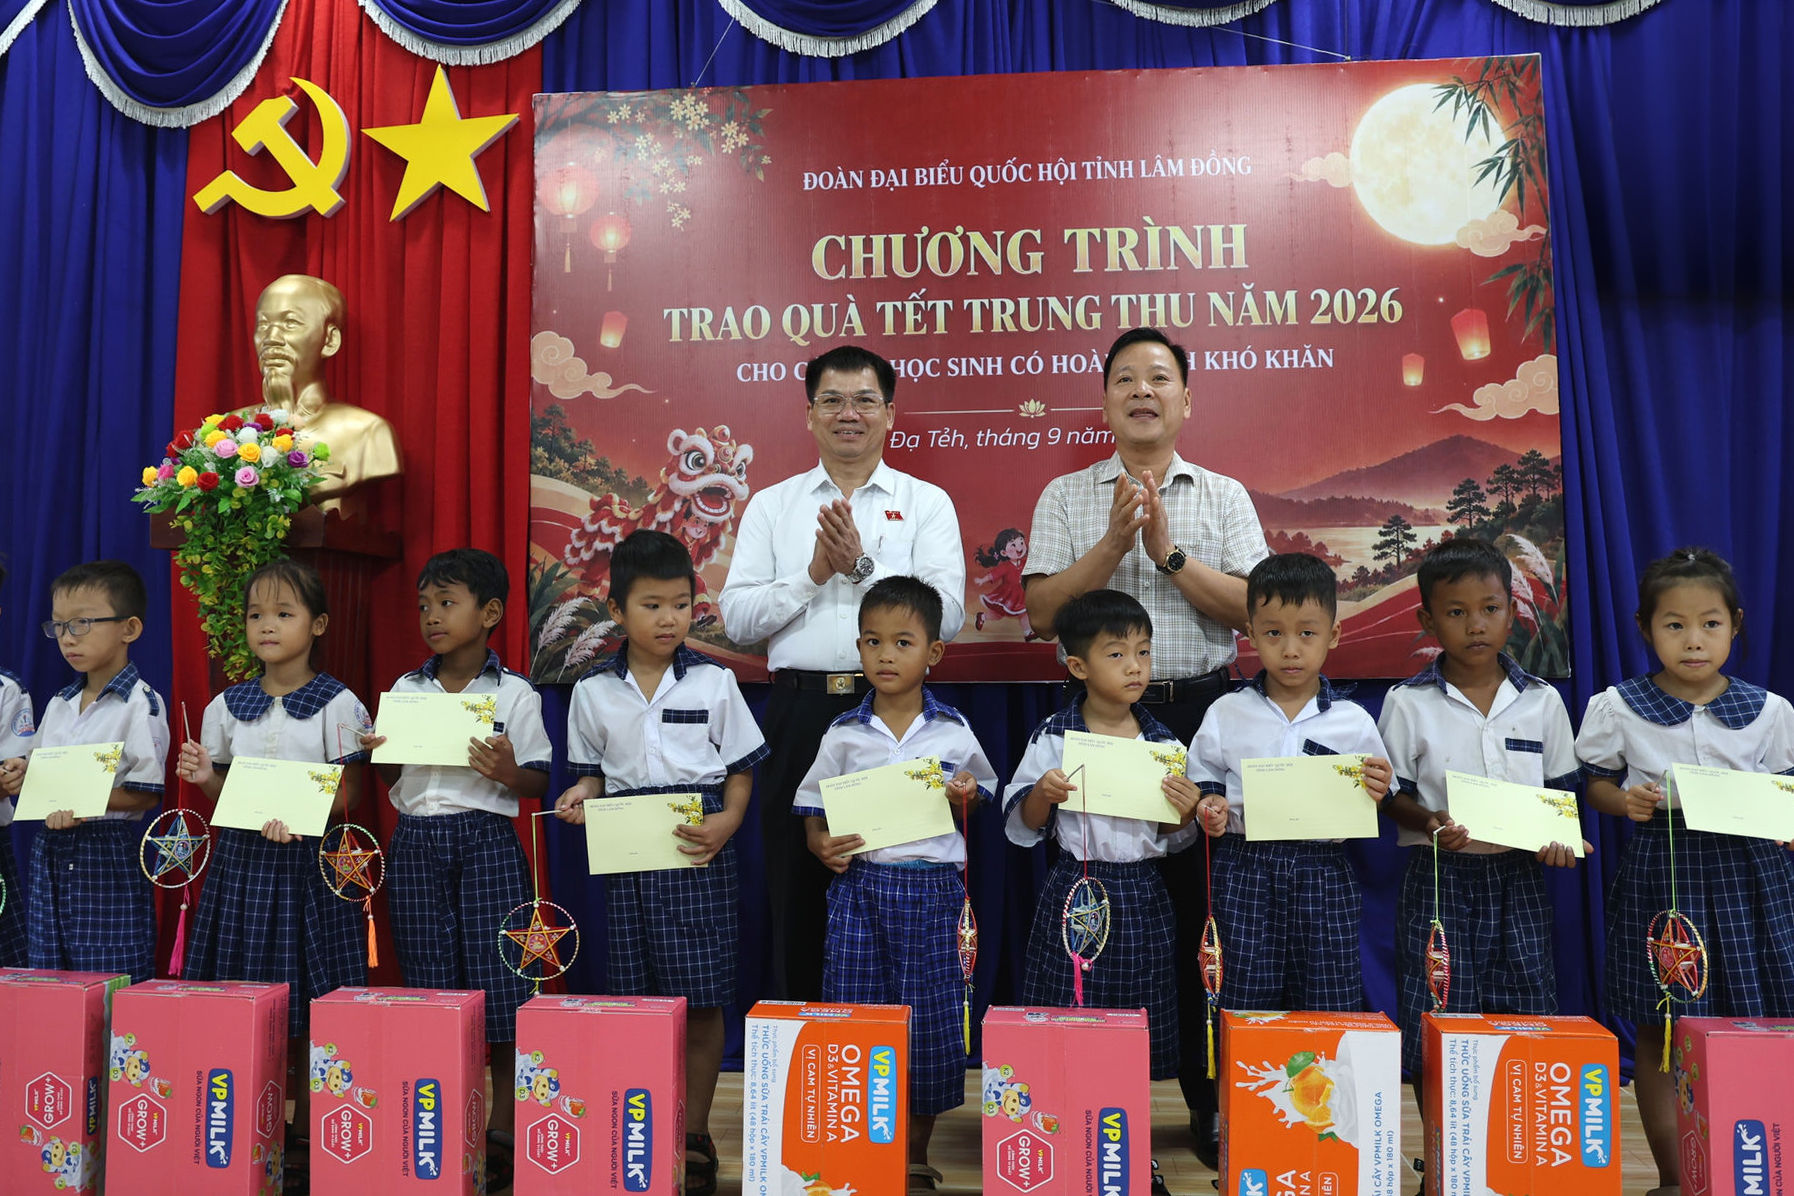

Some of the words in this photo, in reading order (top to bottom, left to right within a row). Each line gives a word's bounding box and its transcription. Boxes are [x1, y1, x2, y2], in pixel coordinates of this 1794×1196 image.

[803, 168, 863, 191] ĐOÀN
[870, 170, 907, 191] ĐẠI
[914, 158, 963, 186] BIỂU
[970, 158, 1031, 187] QUỐC
[1038, 157, 1075, 185] HỘI
[1082, 156, 1134, 179] TỈNH
[1140, 156, 1184, 177] LÂM
[1190, 149, 1252, 176] ĐỒNG
[811, 225, 1044, 280] CHƯƠNG
[1064, 216, 1248, 273] TRÌNH
[663, 305, 771, 343] TRAO
[781, 294, 866, 346] QUÀ
[876, 288, 953, 336] TẾT
[963, 295, 1102, 332] TRUNG
[1111, 292, 1195, 328] THU
[1208, 282, 1298, 327] NĂM
[1310, 287, 1403, 324] 2026
[736, 362, 786, 382] CHO
[947, 356, 1002, 377] SINH
[1010, 350, 1044, 375] CÓ
[1052, 349, 1108, 374] HOÀ
[1204, 346, 1257, 370] KHÓ
[1265, 344, 1335, 369] KHĂN
[890, 431, 920, 452] Đạ
[928, 424, 970, 451] Tẻh,
[975, 427, 1042, 454] tháng
[1048, 427, 1062, 445] 9
[1066, 427, 1115, 444] năm
[751, 1041, 759, 1057] tích
[761, 1025, 770, 1050] THỨC
[1449, 1040, 1459, 1054] Thể
[805, 1049, 816, 1060] VỊ
[1461, 1040, 1470, 1065] THỨC
[761, 1052, 772, 1080] UỐNG
[807, 1062, 816, 1085] CAM
[1449, 1057, 1458, 1073] tích
[1510, 1064, 1521, 1075] VỊ
[761, 1082, 769, 1101] SỮA
[840, 1044, 861, 1143] OMEGA
[1462, 1068, 1472, 1097] UỐNG
[1513, 1078, 1522, 1103] CAM
[44, 1077, 54, 1123] GROW+
[805, 1089, 816, 1103] TỰ
[872, 1051, 890, 1140] VPMILK
[195, 1108, 203, 1123] CỦA
[209, 1073, 228, 1164] VPMILK
[749, 1112, 757, 1126] (48
[760, 1104, 768, 1125] TRÁI
[1374, 1092, 1382, 1127] OMEGA
[1449, 1100, 1457, 1118] 8,64
[1462, 1100, 1470, 1119] SỮA
[1511, 1106, 1523, 1122] TỰ
[1550, 1062, 1572, 1167] OMEGA
[1584, 1069, 1607, 1163] VPMILK
[137, 1099, 148, 1147] GROW+
[418, 1083, 438, 1176] VPMILK
[807, 1106, 818, 1138] NHIÊN
[1772, 1123, 1780, 1141] VIỆT
[340, 1110, 352, 1159] GROW+
[547, 1120, 559, 1169] GROW+
[611, 1130, 619, 1146] CỦA
[627, 1094, 647, 1188] VPMILK
[760, 1127, 768, 1145] CÂY
[1387, 1130, 1395, 1144] ml)
[1449, 1132, 1458, 1146] (48
[1462, 1124, 1471, 1145] TRÁI
[1513, 1124, 1525, 1158] NHIÊN
[193, 1149, 201, 1165] VIỆT
[1086, 1151, 1094, 1166] CỦA
[1374, 1130, 1382, 1165] VPMILK
[1448, 1149, 1458, 1164] hộp
[1463, 1148, 1472, 1167] CÂY
[1737, 1123, 1763, 1195] MILK
[1018, 1136, 1030, 1187] GROW+
[748, 1169, 756, 1182] ml)
[1372, 1168, 1382, 1187] CÂY
[1386, 1171, 1395, 1187] hộp
[1463, 1170, 1471, 1196] VPMI
[1773, 1169, 1782, 1187] CỦA
